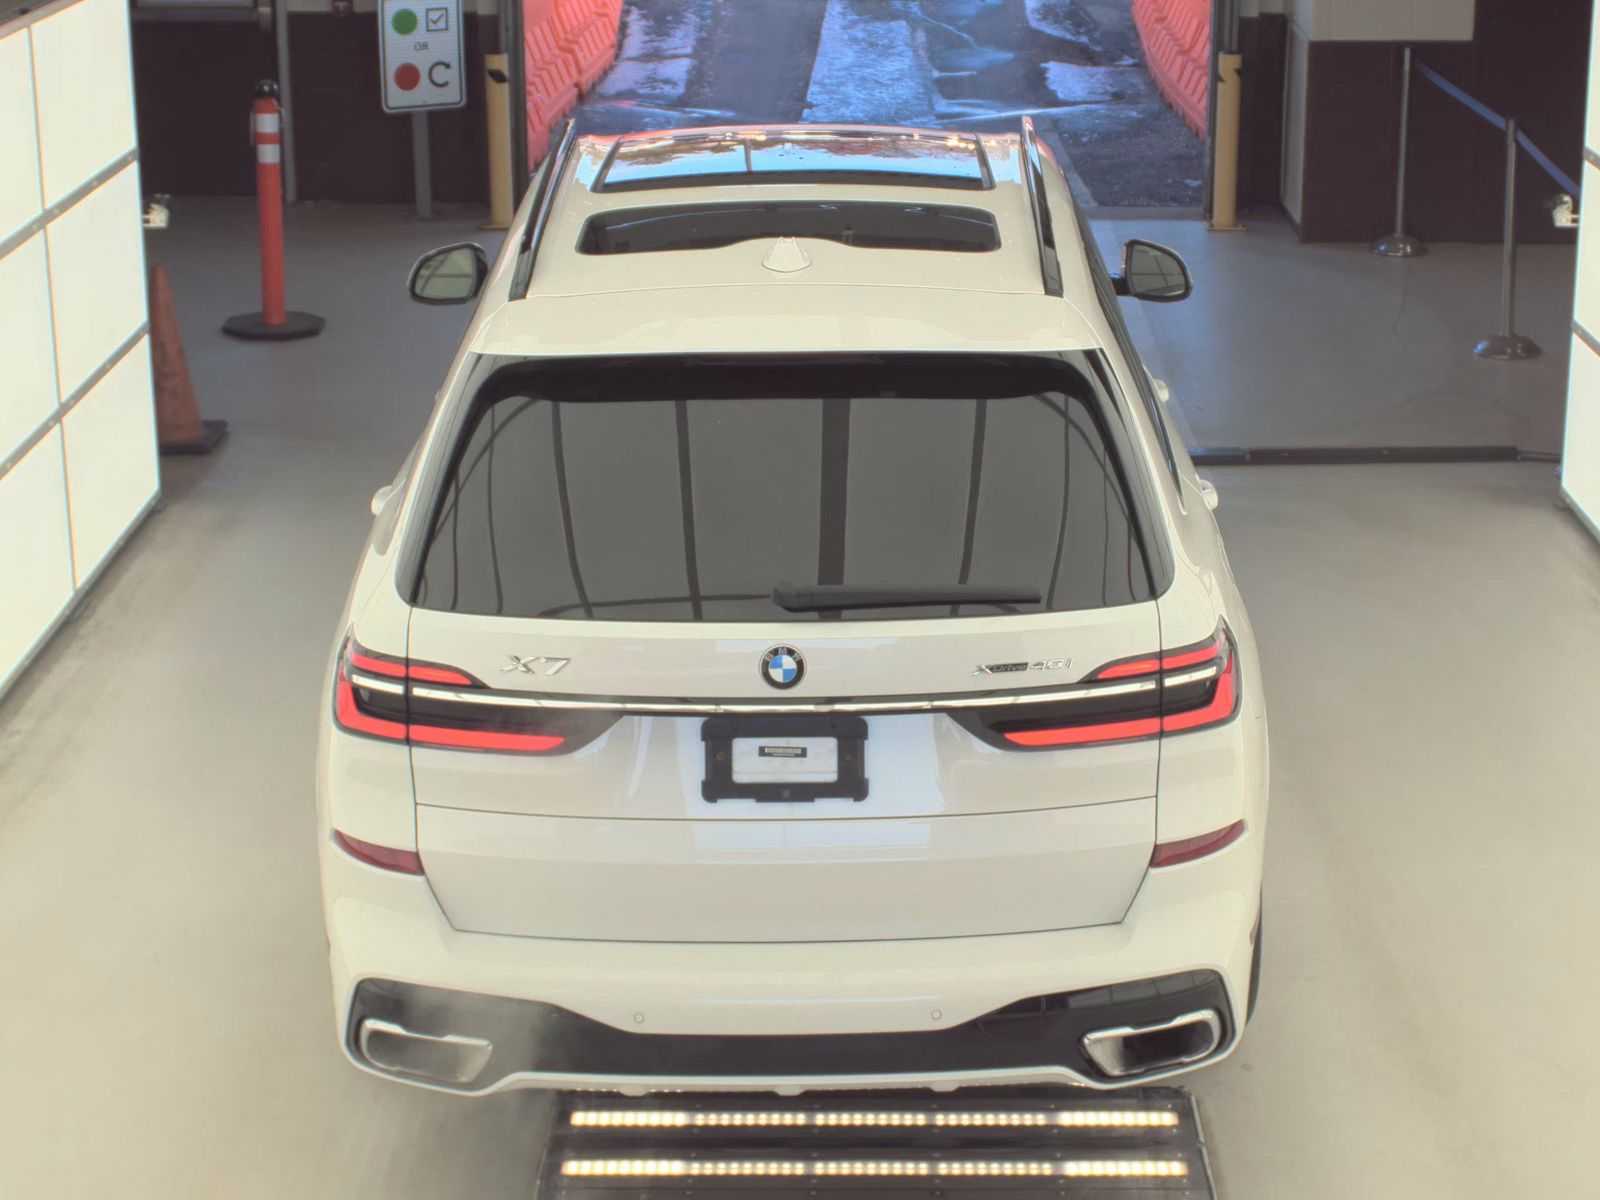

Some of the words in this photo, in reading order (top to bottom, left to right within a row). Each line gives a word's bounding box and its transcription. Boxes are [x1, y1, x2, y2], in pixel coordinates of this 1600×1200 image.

[414, 41, 429, 51] OR
[764, 646, 803, 662] BMW
[499, 655, 572, 675] X7
